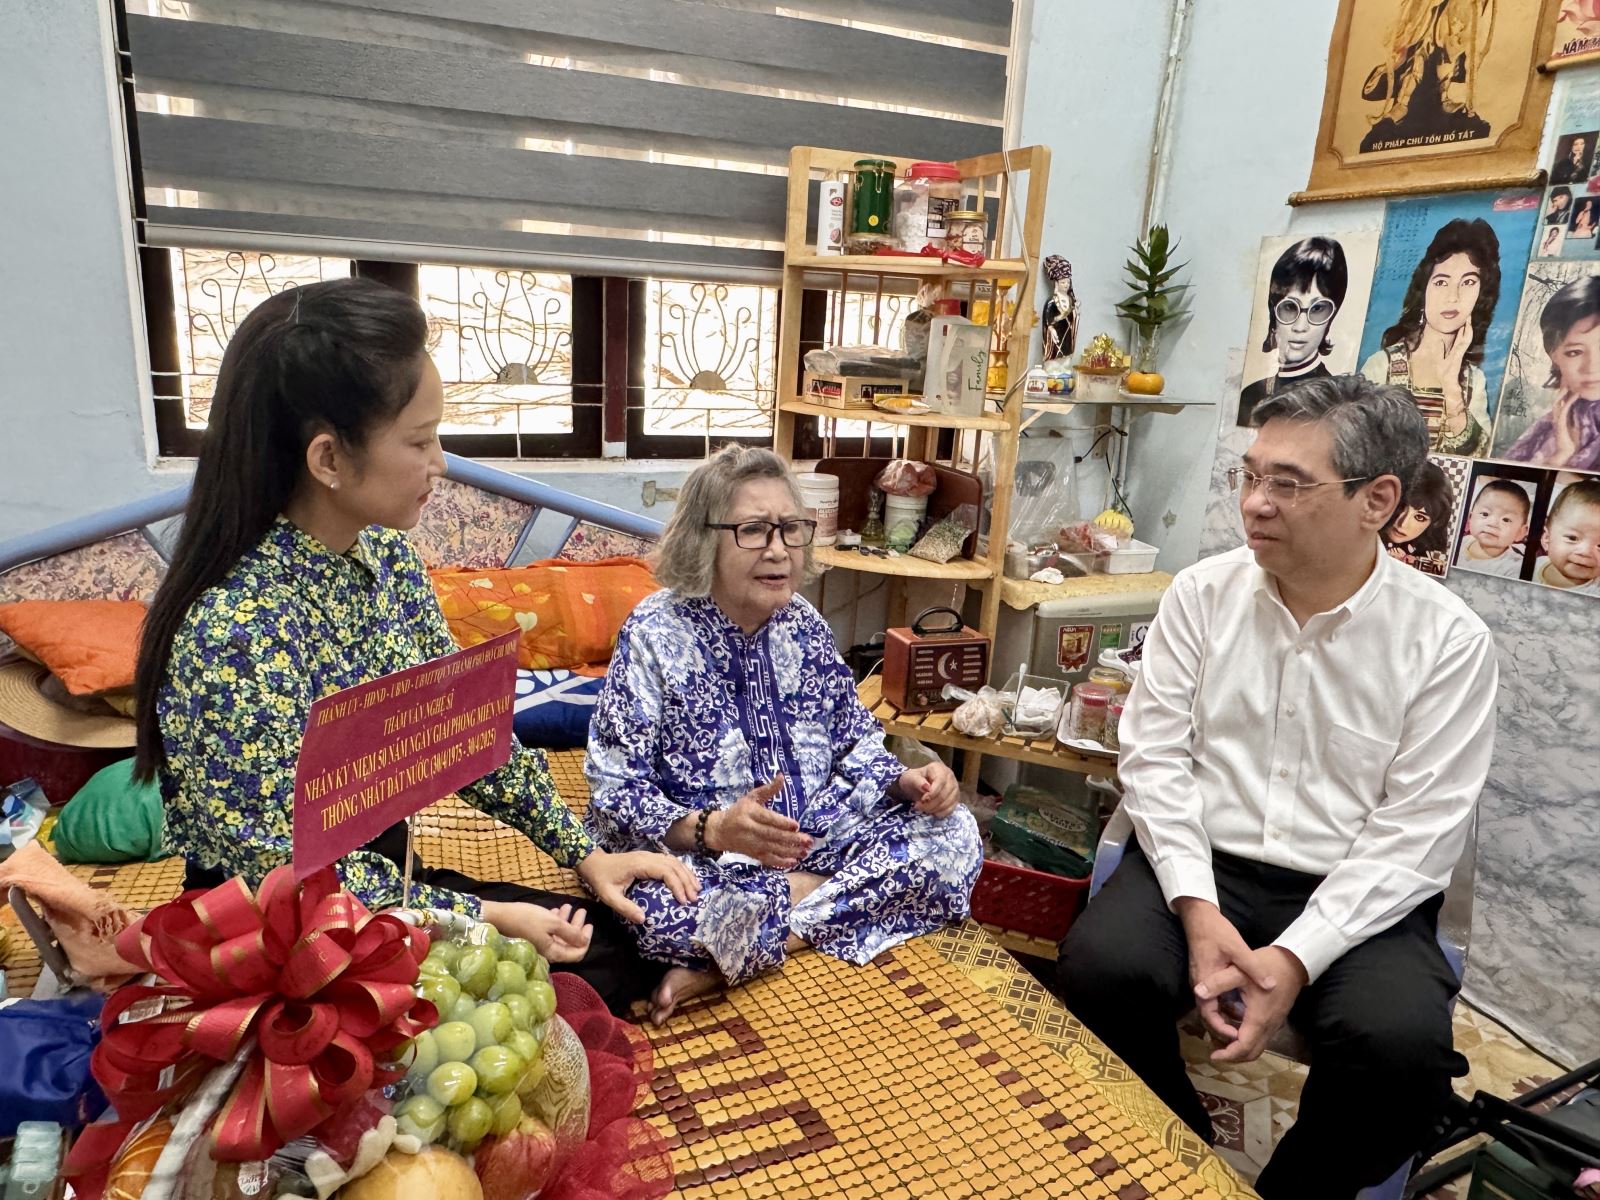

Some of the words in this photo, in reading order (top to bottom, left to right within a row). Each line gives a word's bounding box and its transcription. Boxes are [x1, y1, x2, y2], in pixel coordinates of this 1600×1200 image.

[1372, 140, 1383, 151] HỘ
[1384, 138, 1405, 149] PHÁP
[1425, 134, 1442, 144] TÔN
[317, 701, 347, 727] THÀNH
[304, 768, 334, 804] NHÂN
[352, 752, 376, 782] NIỆM
[377, 747, 387, 770] 50
[388, 737, 408, 765] NĂM
[409, 724, 432, 757] NGÀY
[432, 716, 450, 744] GIẢI
[450, 708, 476, 736] PHÓNG
[476, 699, 495, 724] MIỀN
[495, 694, 511, 717] NAM
[320, 794, 358, 831] THỐNG
[360, 777, 386, 812] NHẤT
[387, 768, 405, 798] ĐẤT
[406, 756, 430, 788] NƯỚC
